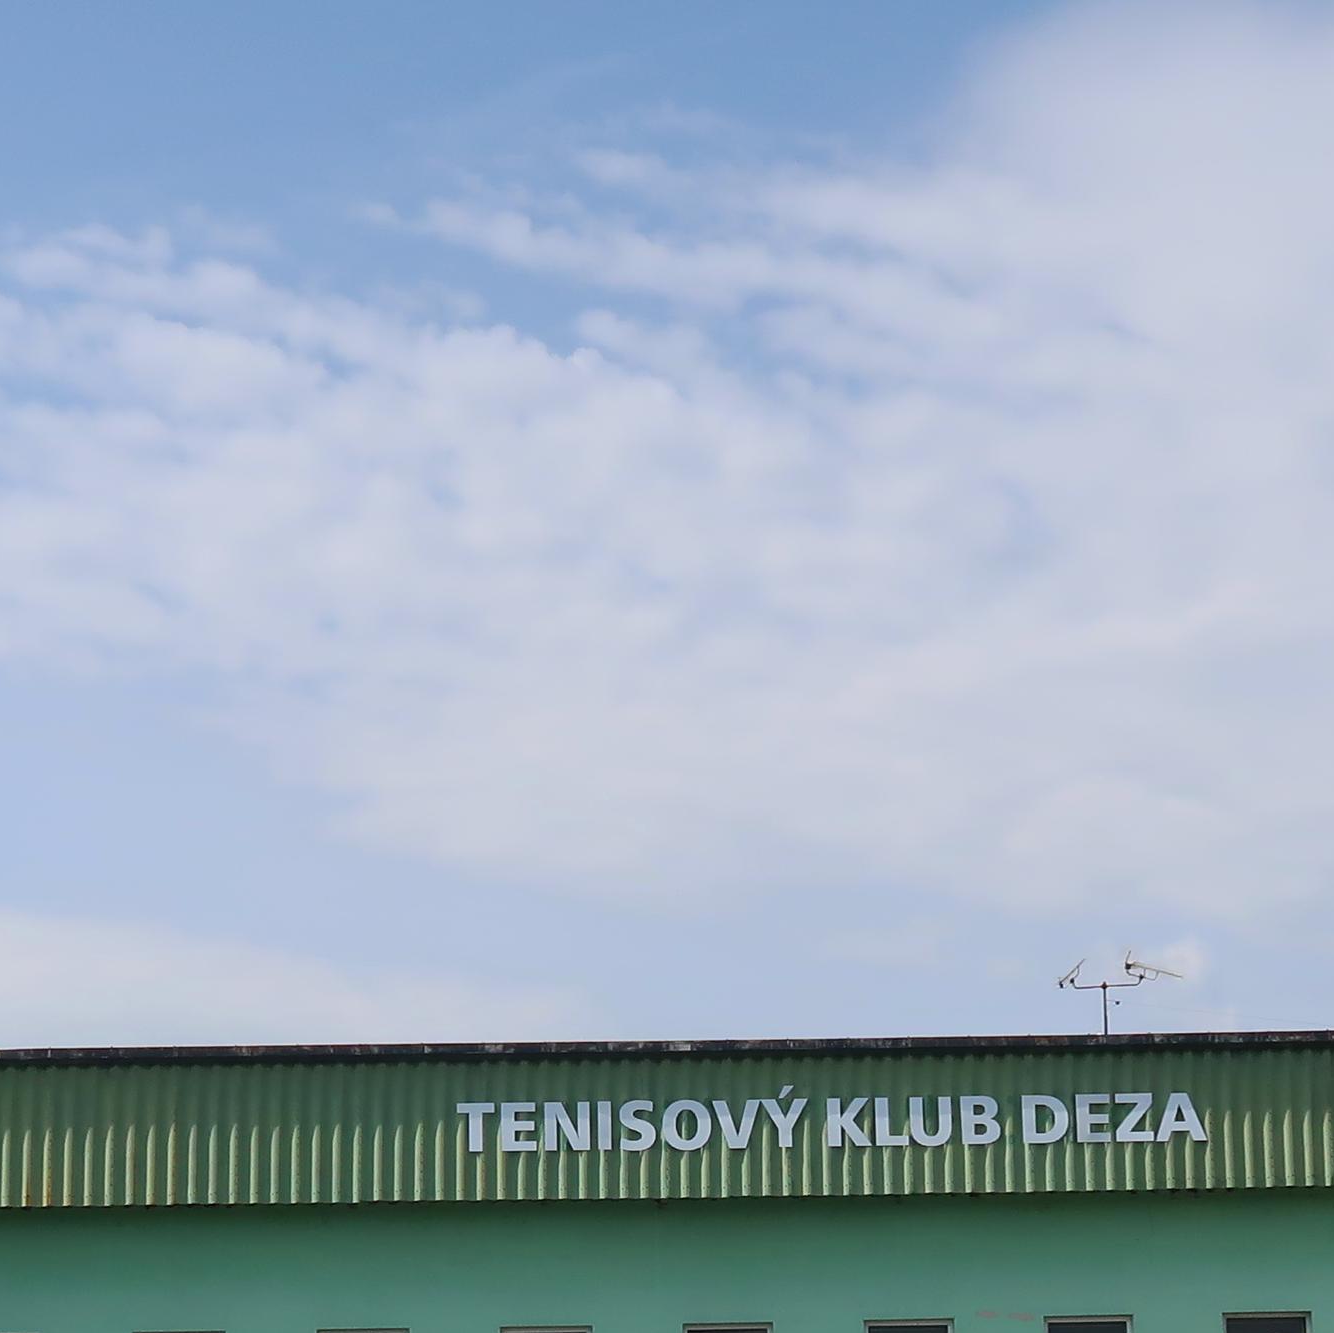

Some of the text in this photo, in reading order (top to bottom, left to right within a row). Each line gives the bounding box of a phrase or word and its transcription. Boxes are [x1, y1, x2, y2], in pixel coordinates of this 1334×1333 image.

[457, 1086, 1208, 1153] TENISOVÝ KLUB DEZA
